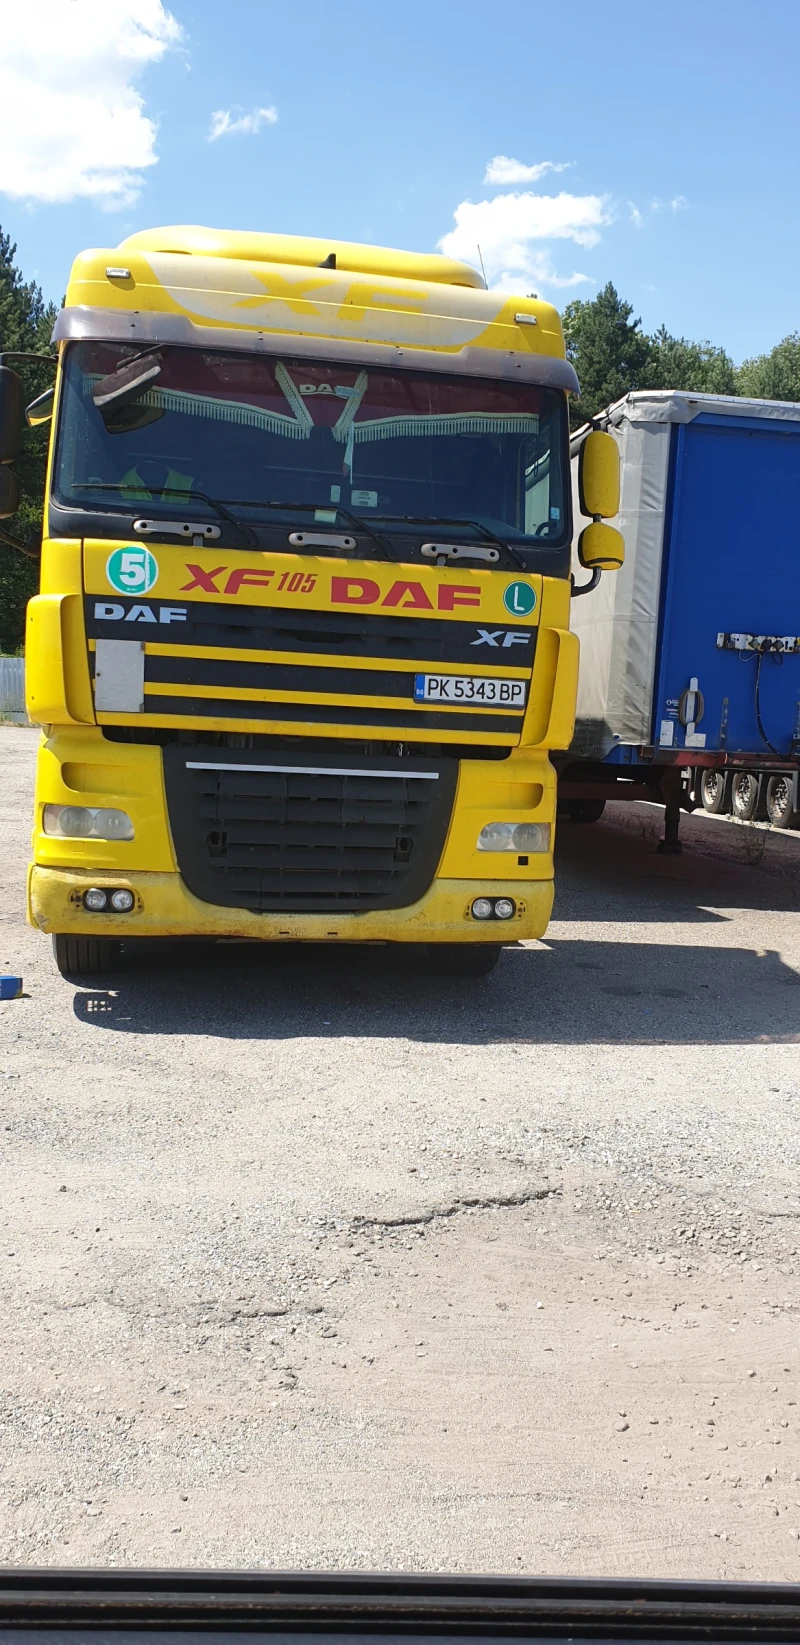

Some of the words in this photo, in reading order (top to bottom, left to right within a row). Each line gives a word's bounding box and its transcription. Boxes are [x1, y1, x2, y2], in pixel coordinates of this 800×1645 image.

[231, 271, 428, 321] XF
[300, 383, 340, 394] DA
[119, 553, 146, 586] 5
[179, 563, 276, 595] XF
[276, 571, 318, 594] 105
[330, 577, 481, 611] DAF
[514, 585, 525, 611] L
[94, 602, 188, 624] DAF
[470, 628, 532, 648] XF
[427, 678, 450, 697] PK
[454, 680, 496, 700] 5343
[499, 683, 522, 701] BP
